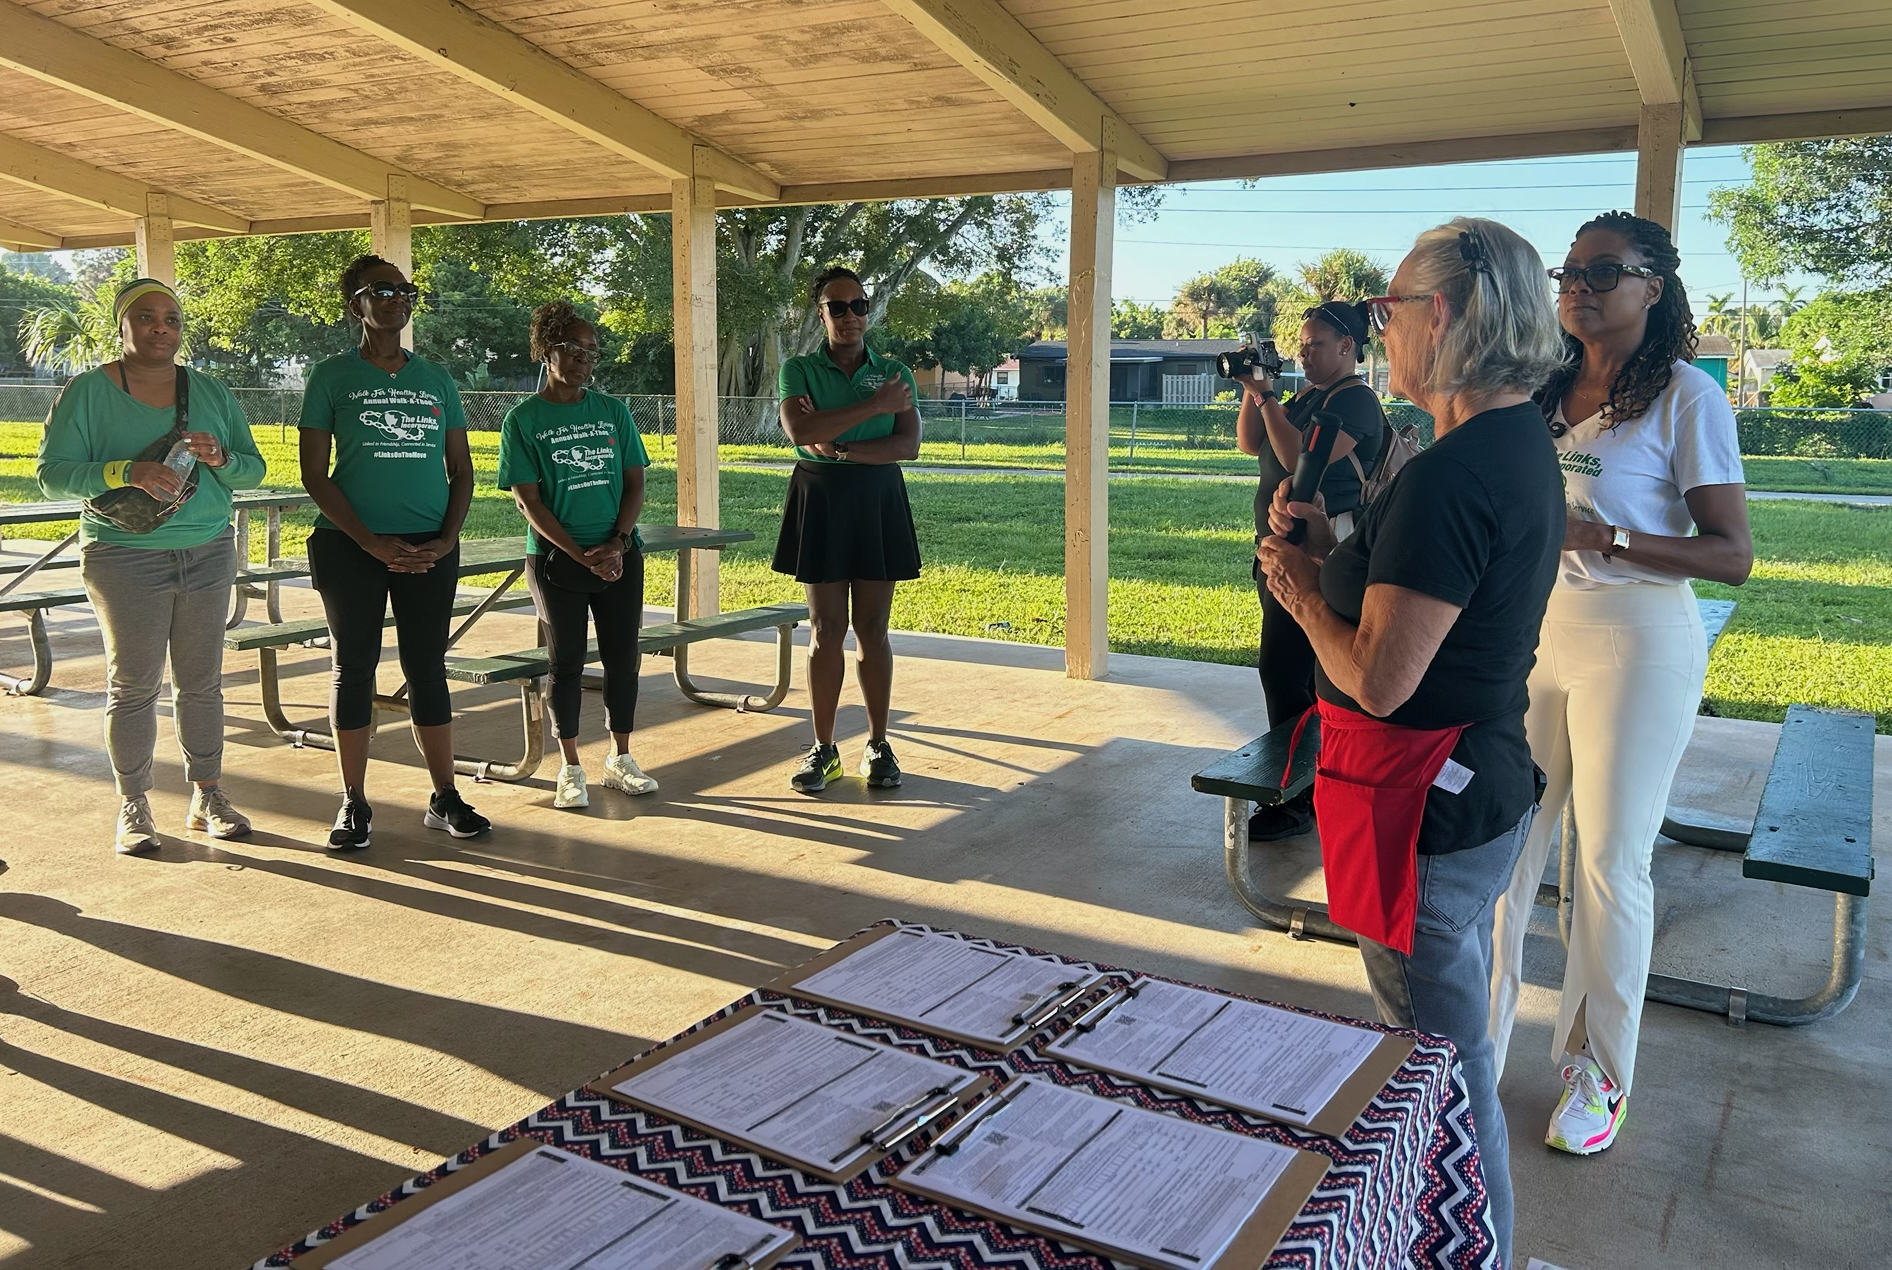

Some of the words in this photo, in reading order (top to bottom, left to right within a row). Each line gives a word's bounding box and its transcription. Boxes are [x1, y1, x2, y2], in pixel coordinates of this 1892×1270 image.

[349, 391, 369, 400] Walk
[370, 388, 386, 398] For
[388, 388, 416, 398] Healthy
[390, 397, 432, 405] Walk-A-Thon
[402, 415, 414, 424] The
[416, 416, 438, 425] Links,
[400, 422, 438, 431] Incorporated
[570, 423, 596, 433] Healthy
[550, 434, 572, 443] Annual
[573, 431, 609, 440] Walk-A-Thon
[1562, 451, 1600, 468] Links,
